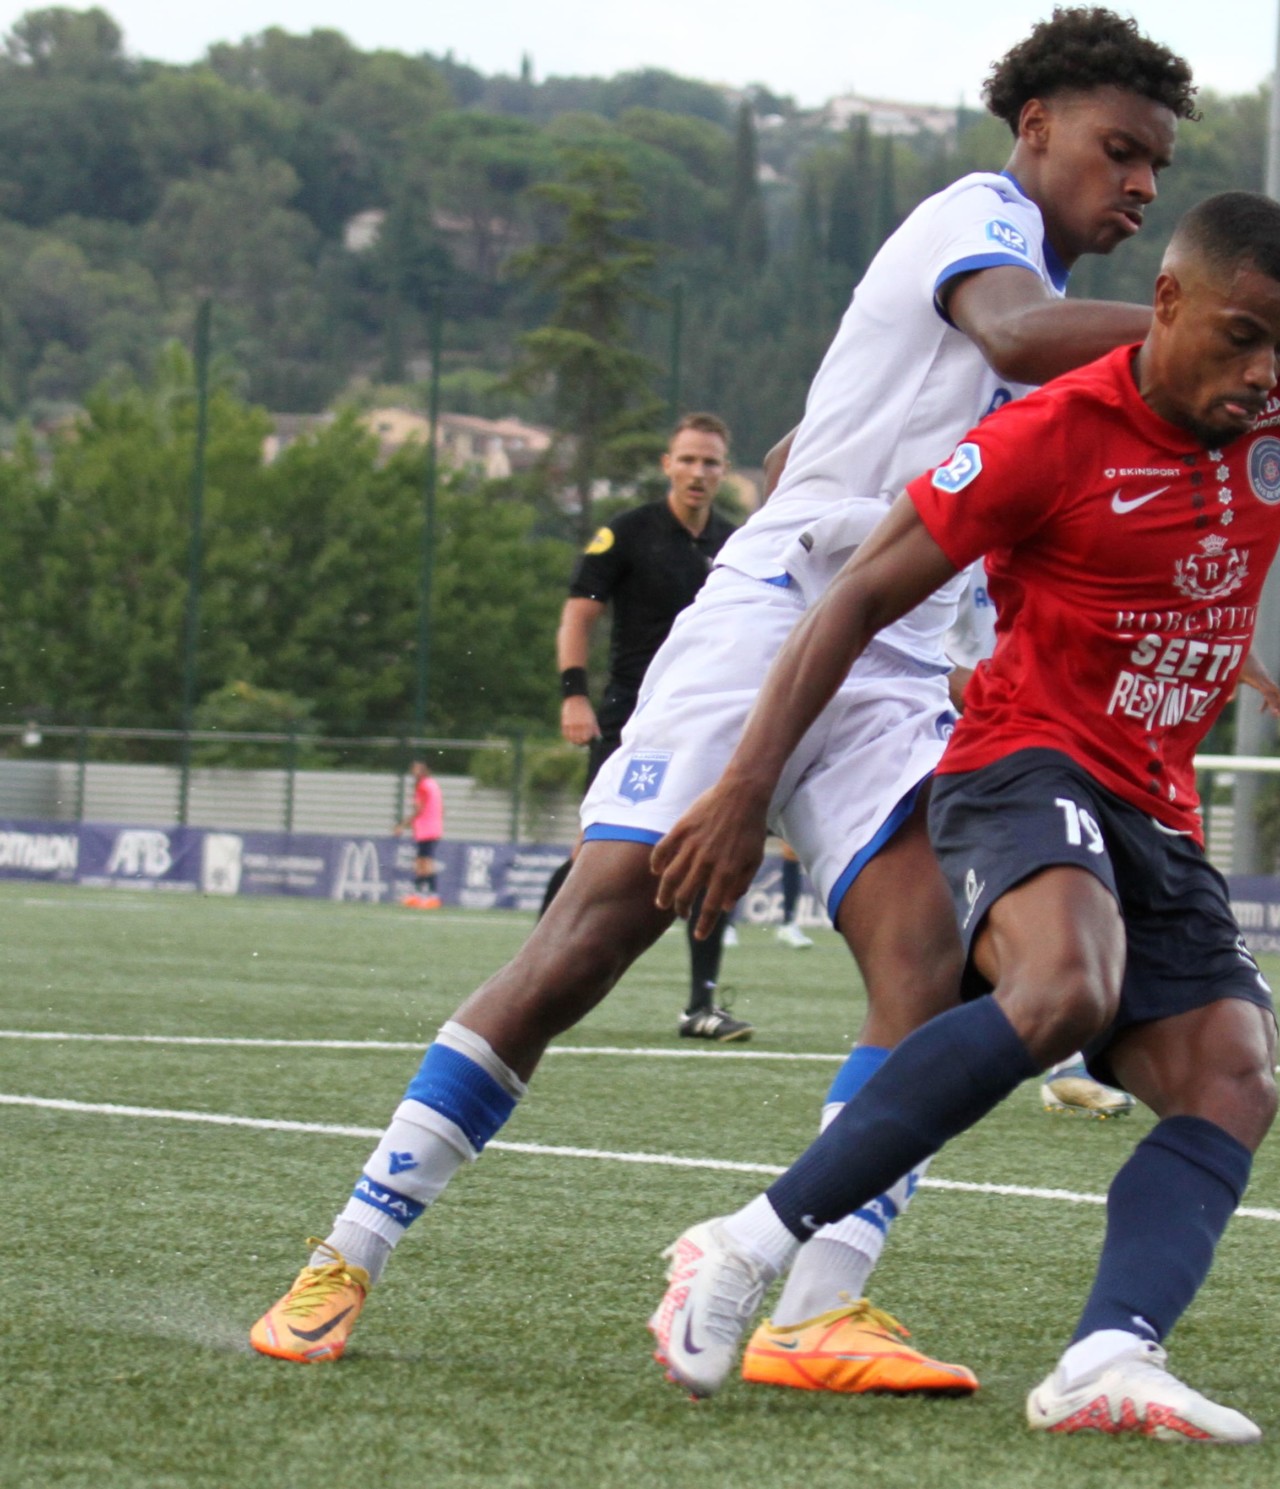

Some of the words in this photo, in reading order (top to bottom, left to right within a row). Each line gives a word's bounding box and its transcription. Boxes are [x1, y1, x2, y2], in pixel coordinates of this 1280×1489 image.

[1119, 467, 1181, 477] EKINSPORT
[1205, 562, 1219, 581] R
[1130, 633, 1244, 682] SEETP
[1055, 797, 1105, 854] 19
